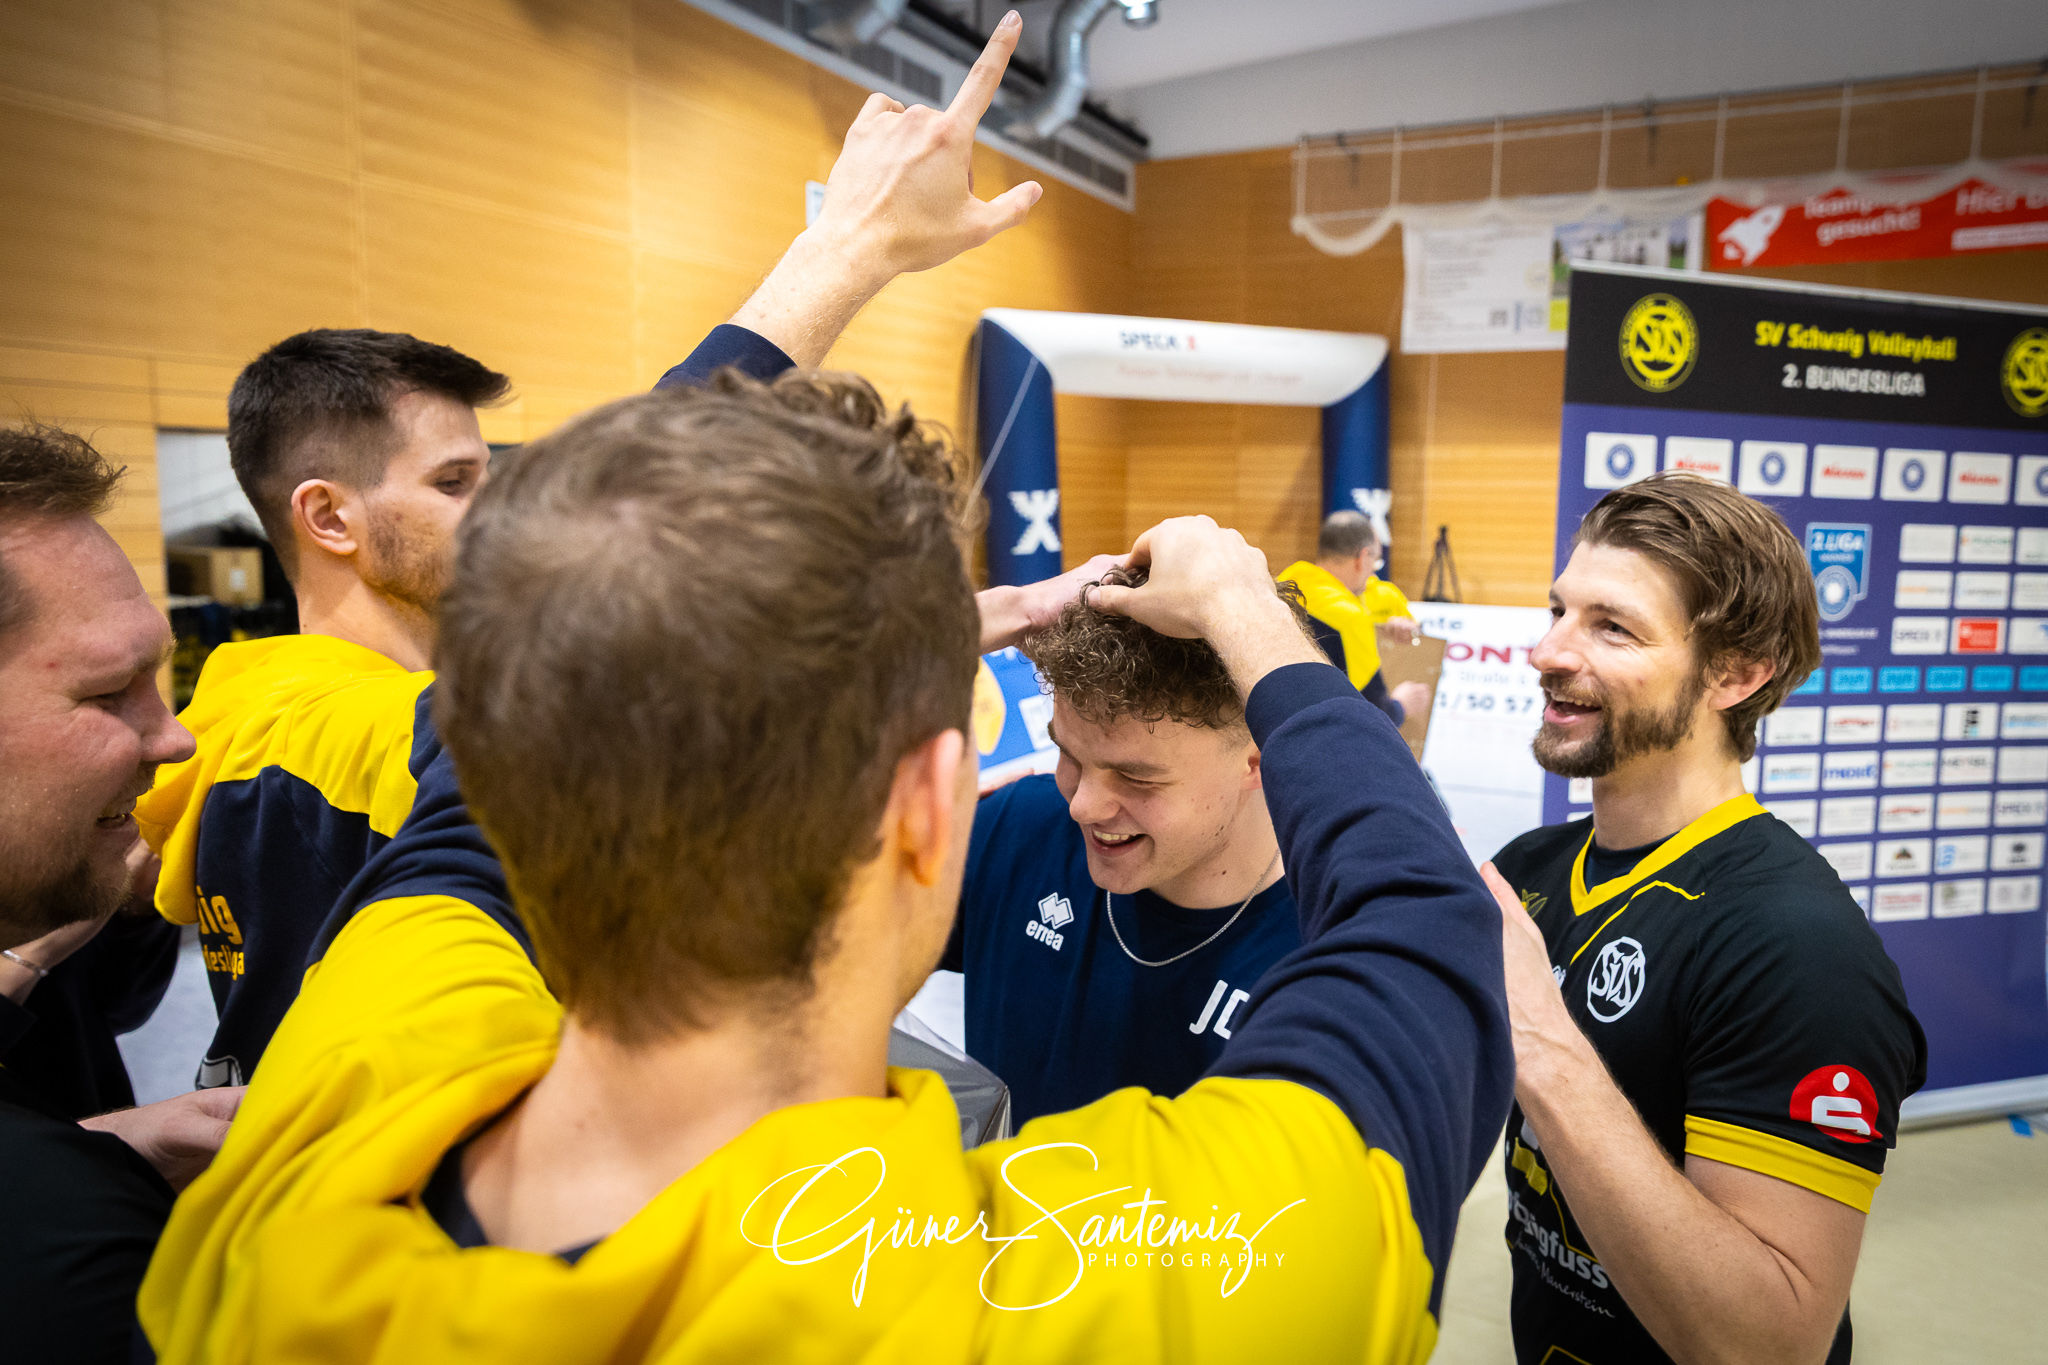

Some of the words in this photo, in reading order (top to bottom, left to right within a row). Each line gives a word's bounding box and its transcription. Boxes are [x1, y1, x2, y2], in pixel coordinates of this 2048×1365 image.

[1755, 320, 1786, 346] SV
[1787, 323, 1865, 358] Schwaig
[1867, 329, 1957, 363] Volleyball
[1781, 363, 1802, 388] 2.
[1805, 364, 1926, 397] BUNDESLIGA
